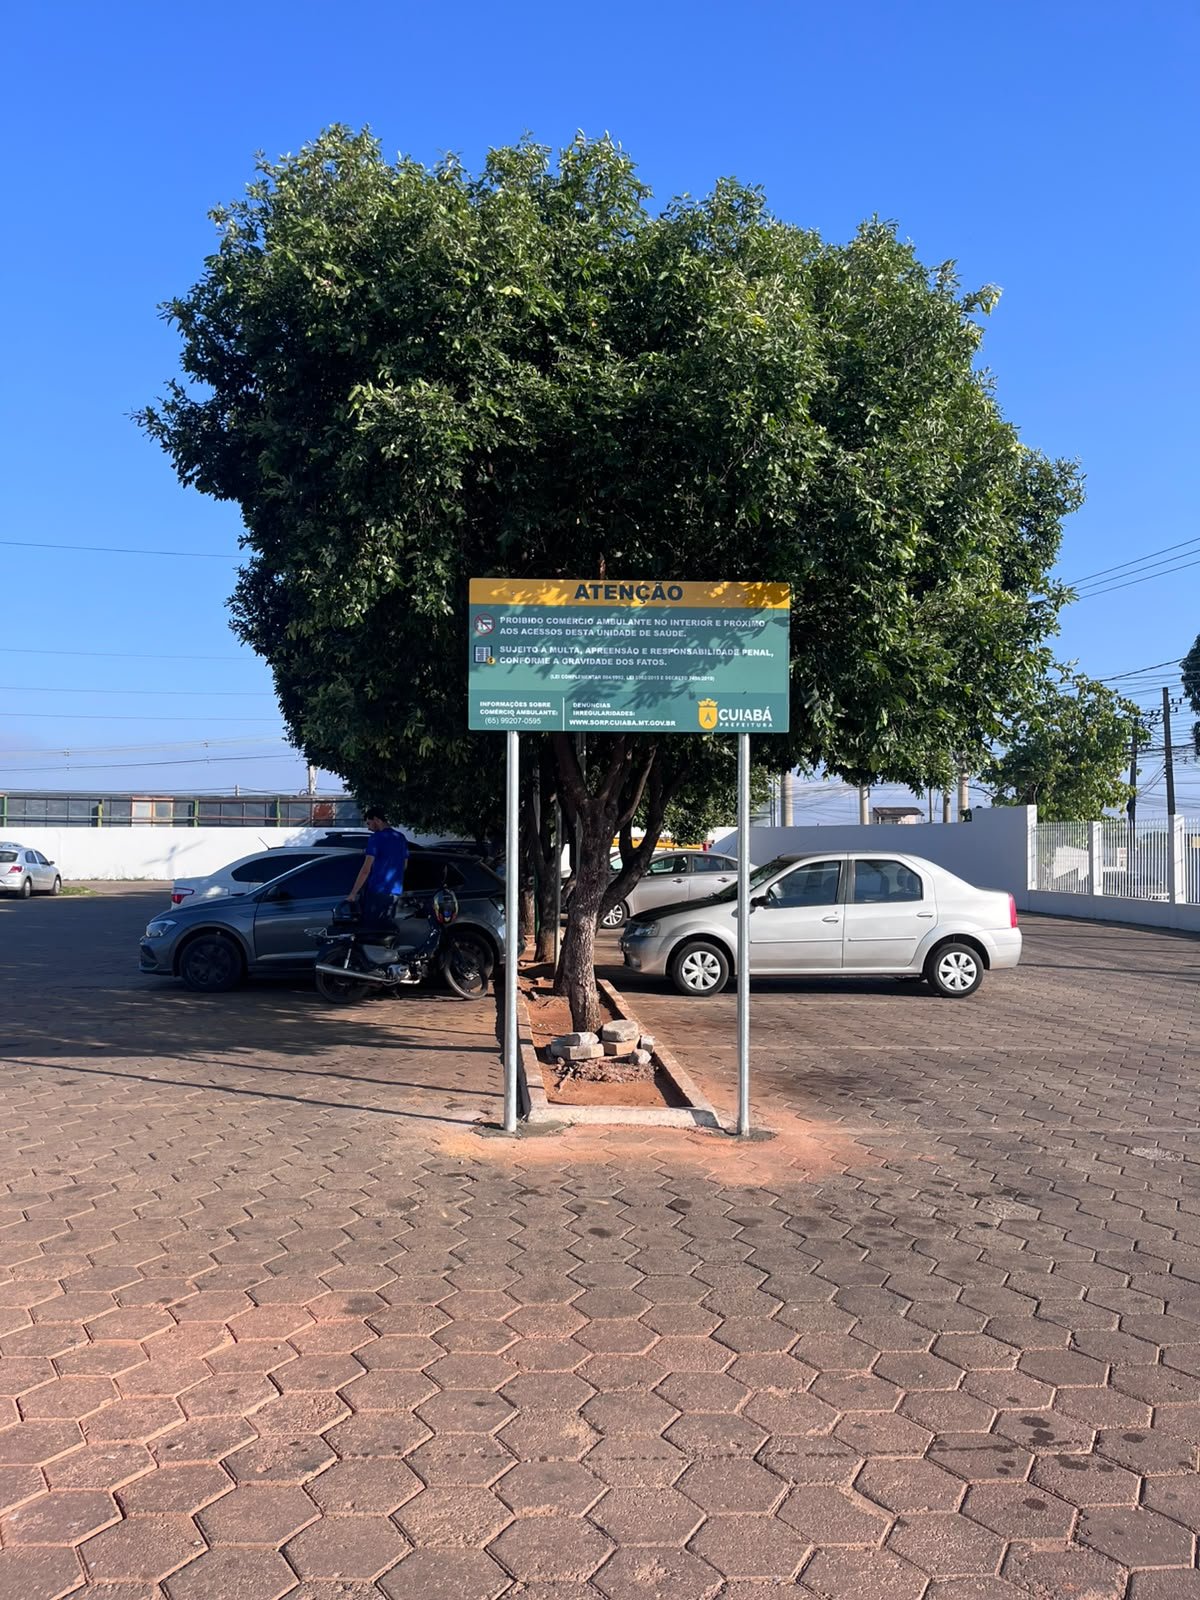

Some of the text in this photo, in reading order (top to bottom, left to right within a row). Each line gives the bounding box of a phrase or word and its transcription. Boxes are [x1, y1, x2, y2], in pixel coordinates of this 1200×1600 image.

[574, 581, 683, 604] ATENÇÃO
[499, 615, 766, 628] PROIBIDO COMÉRCIO AMBULANTE NO INTERIOR E PRÓXIMO
[499, 628, 519, 636] AOS
[520, 628, 563, 636] ACESSOS
[596, 629, 637, 637] UNIDADE
[639, 629, 651, 637] DE
[653, 629, 687, 638] SAÚDE.
[499, 646, 539, 654] SUJEITO
[540, 646, 547, 654] A
[549, 646, 583, 655] MULTA,
[585, 646, 639, 655] APREENSÃO
[650, 648, 740, 656] RESPONSABILIDADE
[741, 648, 774, 658] PENAL,
[499, 656, 668, 666] CONFORME A GRAVIDADE DOS FATOS.
[718, 706, 773, 722] CUIABÁ
[484, 717, 500, 725] (65)
